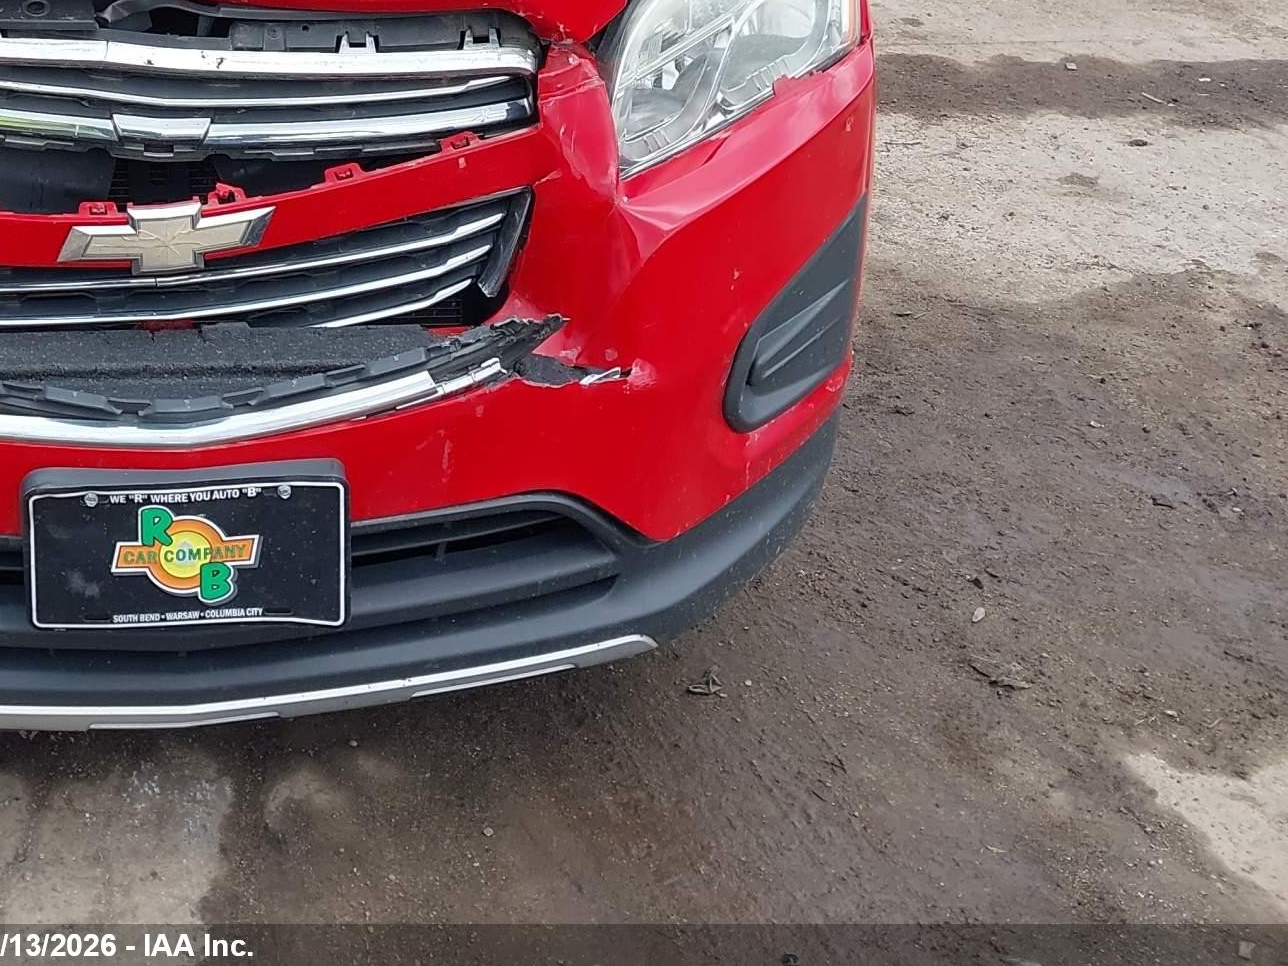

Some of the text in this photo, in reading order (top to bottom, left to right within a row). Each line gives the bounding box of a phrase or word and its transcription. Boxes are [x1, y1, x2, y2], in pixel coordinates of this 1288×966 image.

[109, 494, 127, 505] WE
[150, 493, 189, 504] WHERE
[189, 491, 211, 502] YOU
[211, 489, 240, 500] AUTO
[141, 507, 174, 547] R
[122, 543, 247, 565] CAR COMPANY
[198, 562, 233, 602] B
[112, 607, 264, 623] SOUTH BEND WARSAW COLUMBIA CITY
